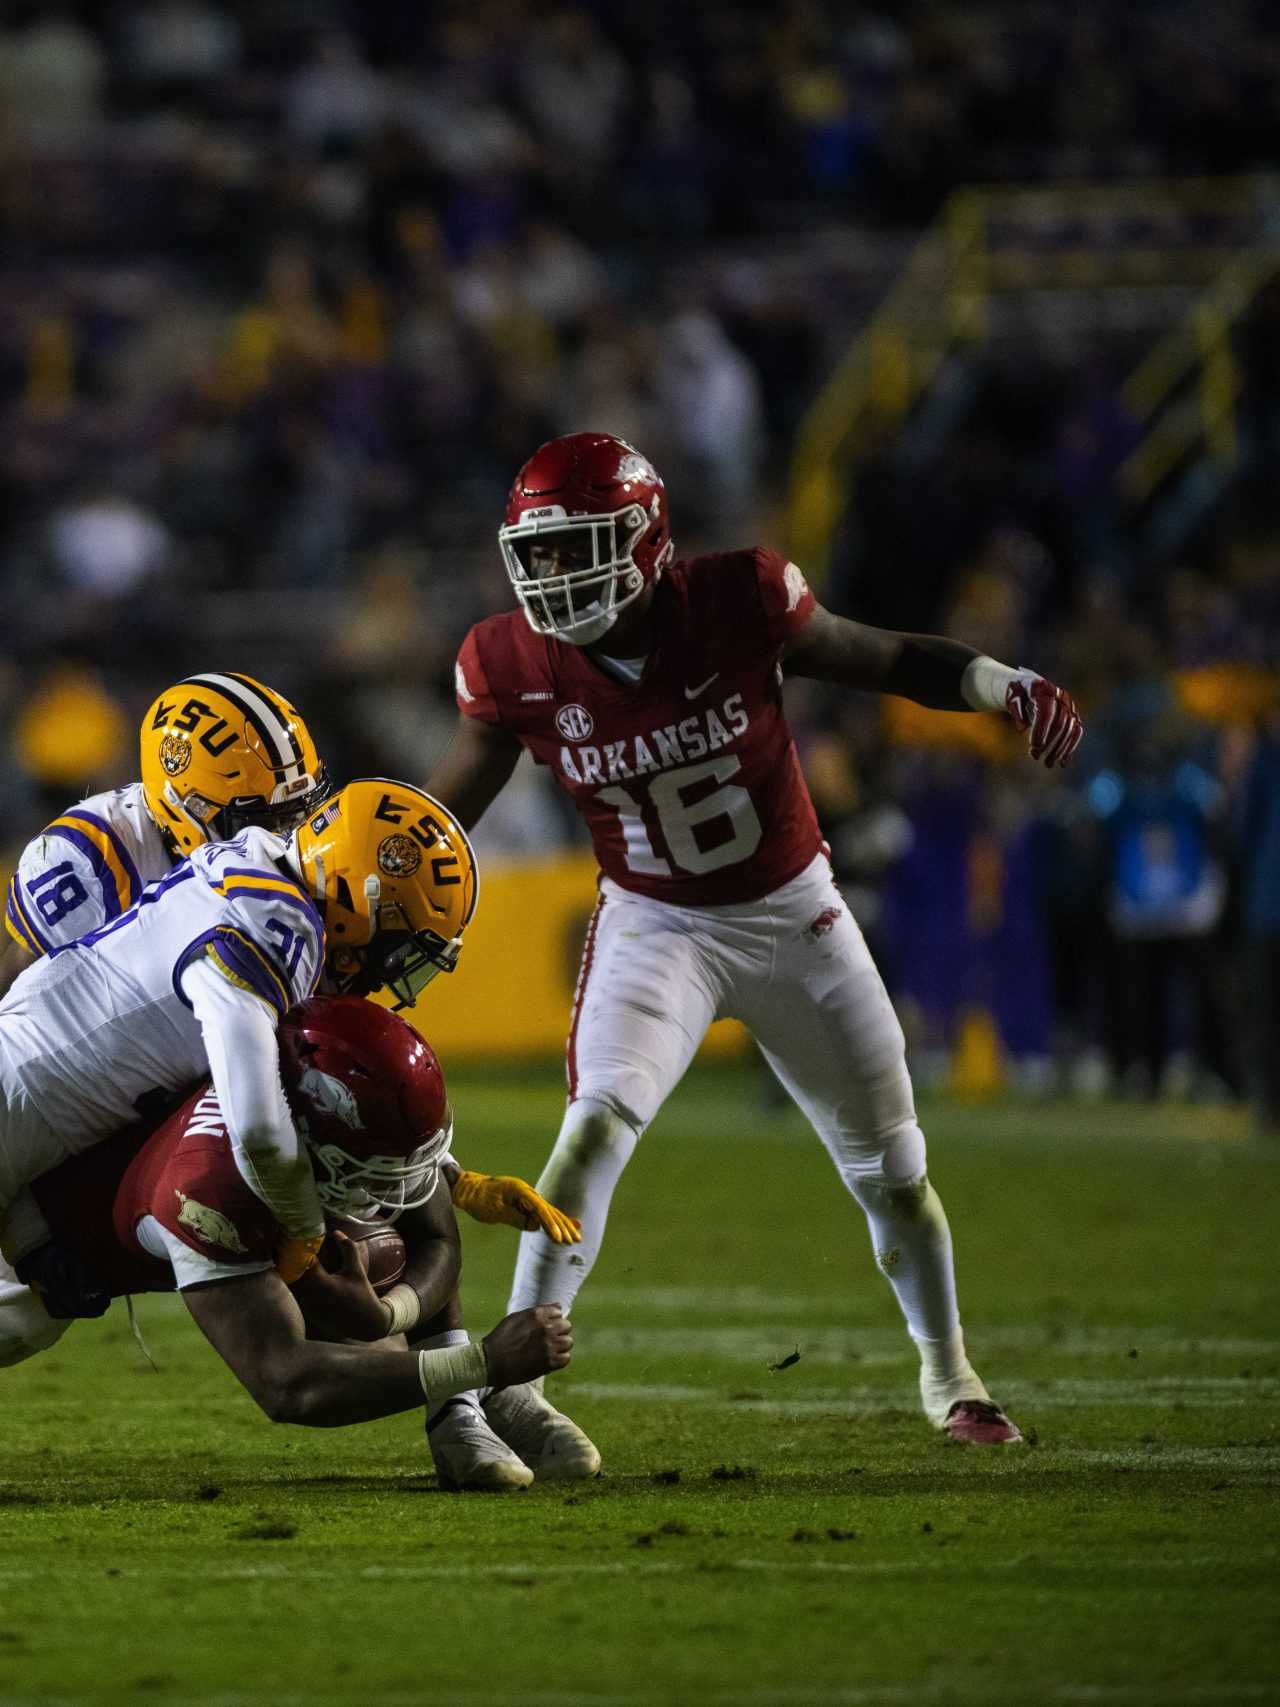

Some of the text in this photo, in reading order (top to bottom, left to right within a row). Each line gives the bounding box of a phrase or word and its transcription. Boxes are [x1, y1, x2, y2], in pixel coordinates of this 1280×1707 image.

[152, 699, 239, 757] LSU
[560, 707, 590, 739] SEC
[560, 692, 749, 784] ARKANSAS
[375, 794, 461, 886] LSU
[593, 753, 763, 876] 16
[26, 861, 89, 926] 18
